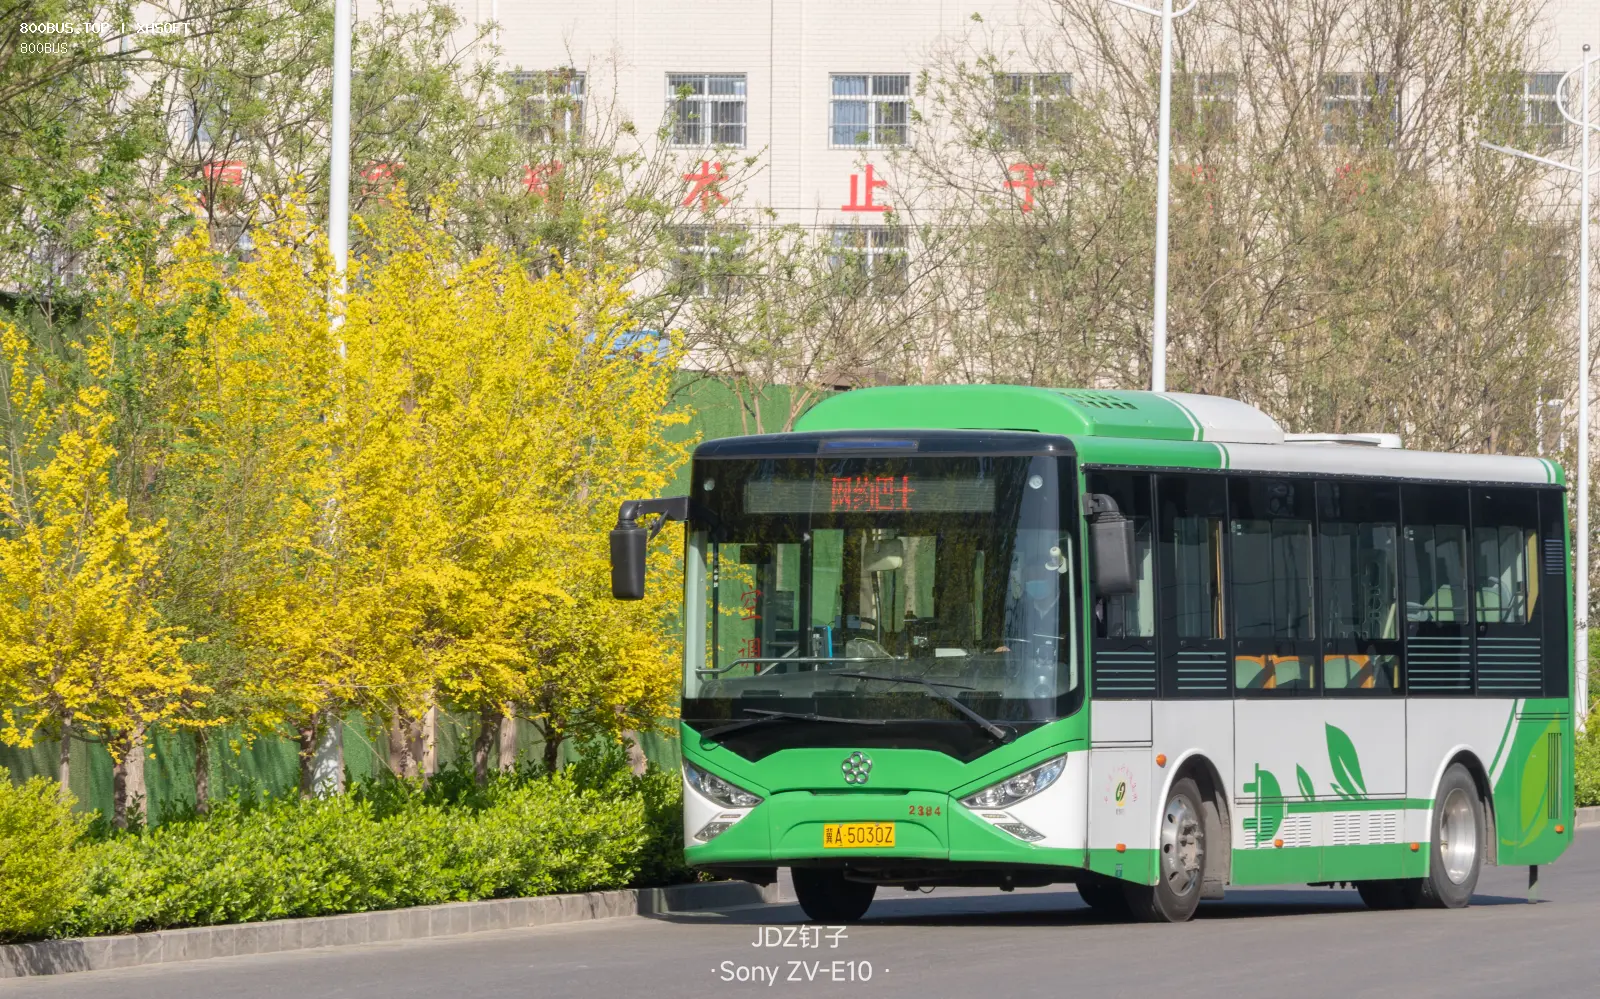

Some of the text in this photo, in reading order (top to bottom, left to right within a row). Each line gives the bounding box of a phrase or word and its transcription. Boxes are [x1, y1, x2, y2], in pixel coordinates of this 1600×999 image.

[831, 475, 916, 512] 网约巴士
[738, 585, 763, 674] 空调
